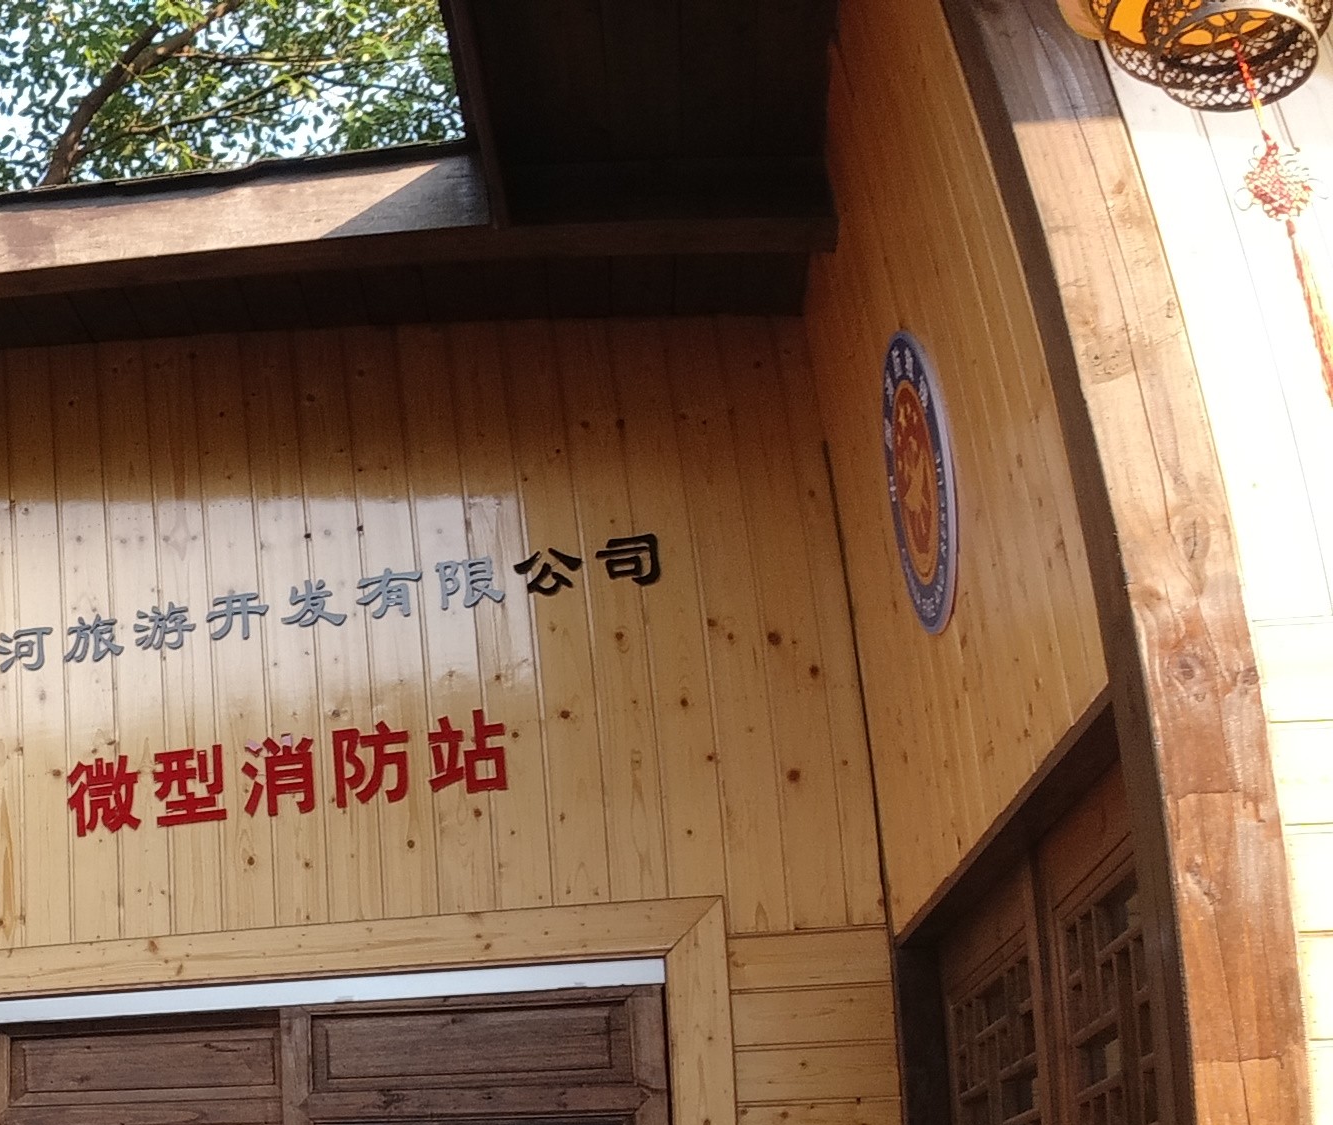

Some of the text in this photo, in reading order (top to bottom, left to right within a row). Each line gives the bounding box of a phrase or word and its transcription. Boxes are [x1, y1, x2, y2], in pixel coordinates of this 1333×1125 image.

[65, 708, 509, 838] 微型消防站
